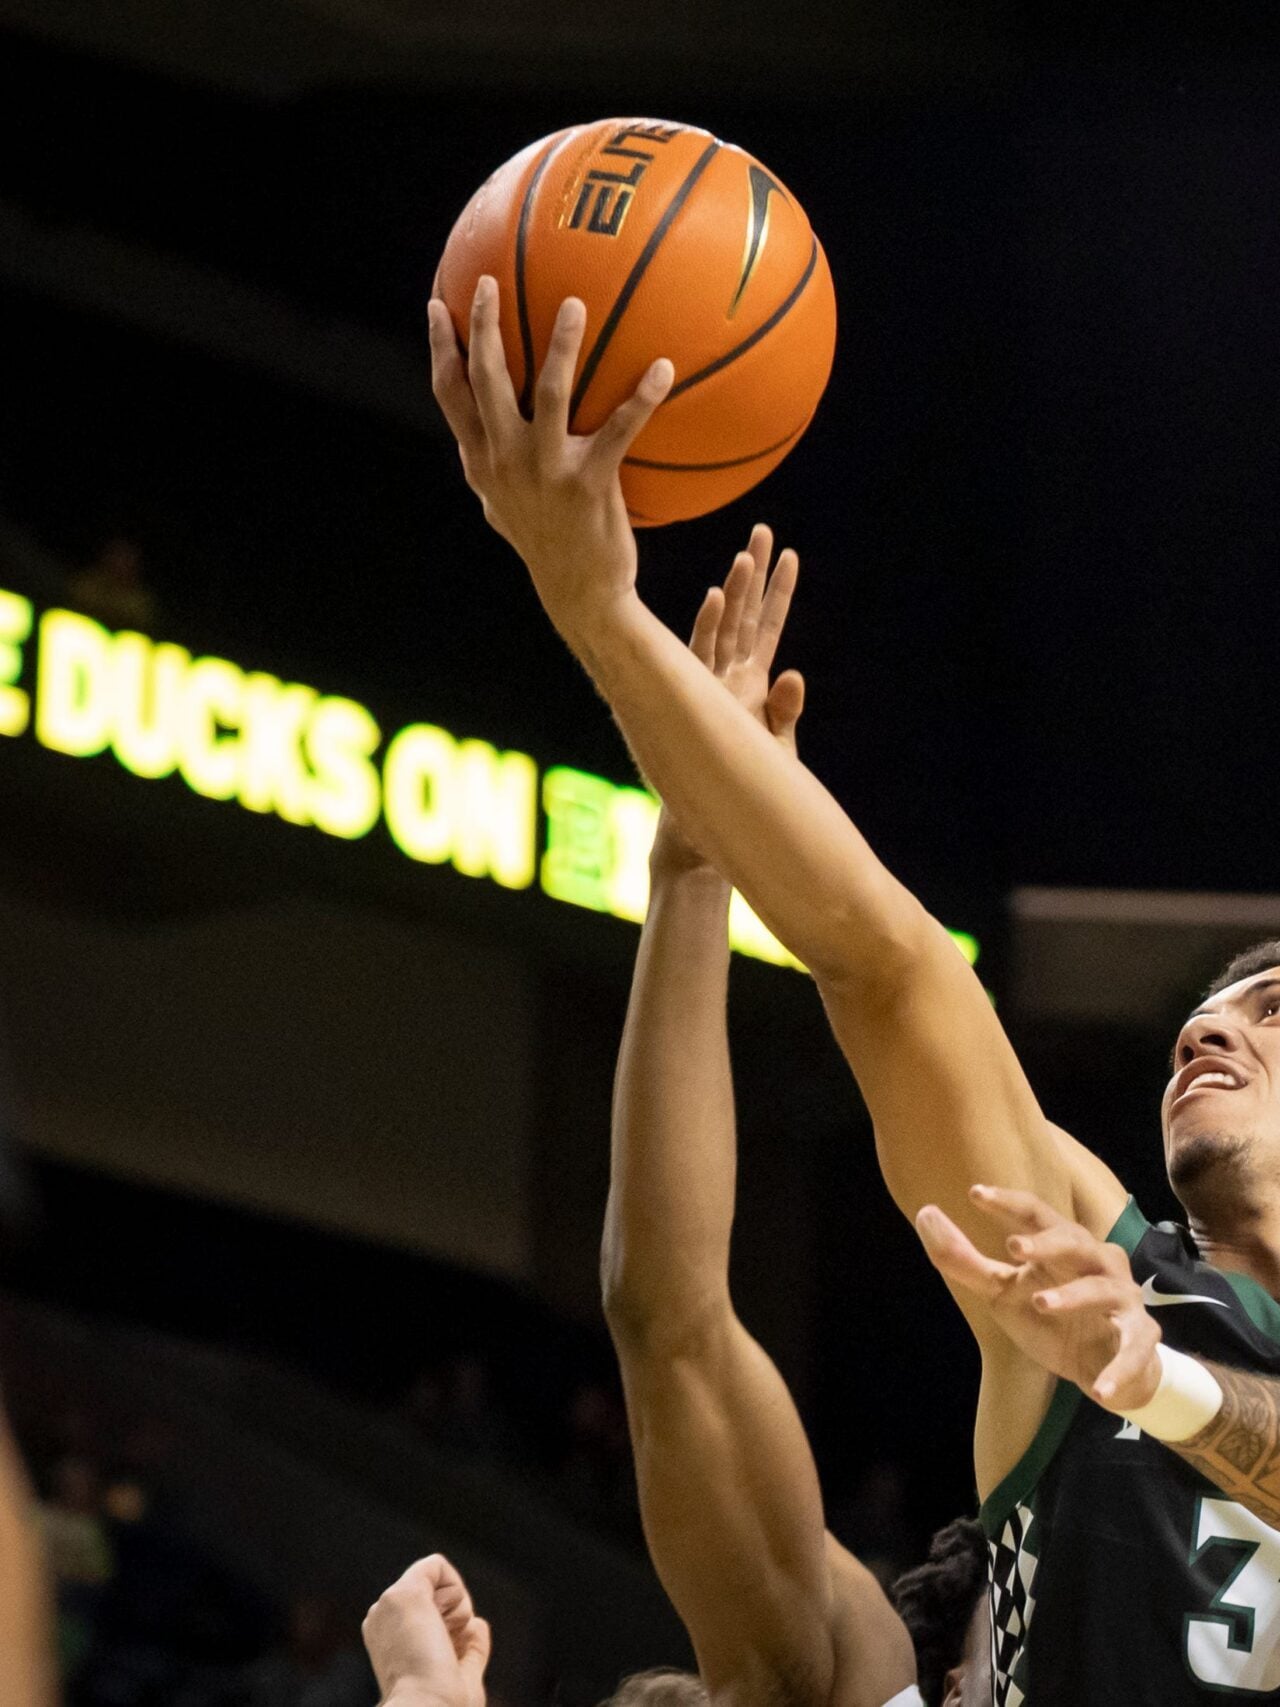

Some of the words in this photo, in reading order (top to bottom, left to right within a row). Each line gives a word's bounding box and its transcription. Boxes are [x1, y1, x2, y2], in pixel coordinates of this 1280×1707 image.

[567, 122, 684, 239] ELITE
[36, 608, 382, 840] DUCKS
[383, 722, 539, 891] ON
